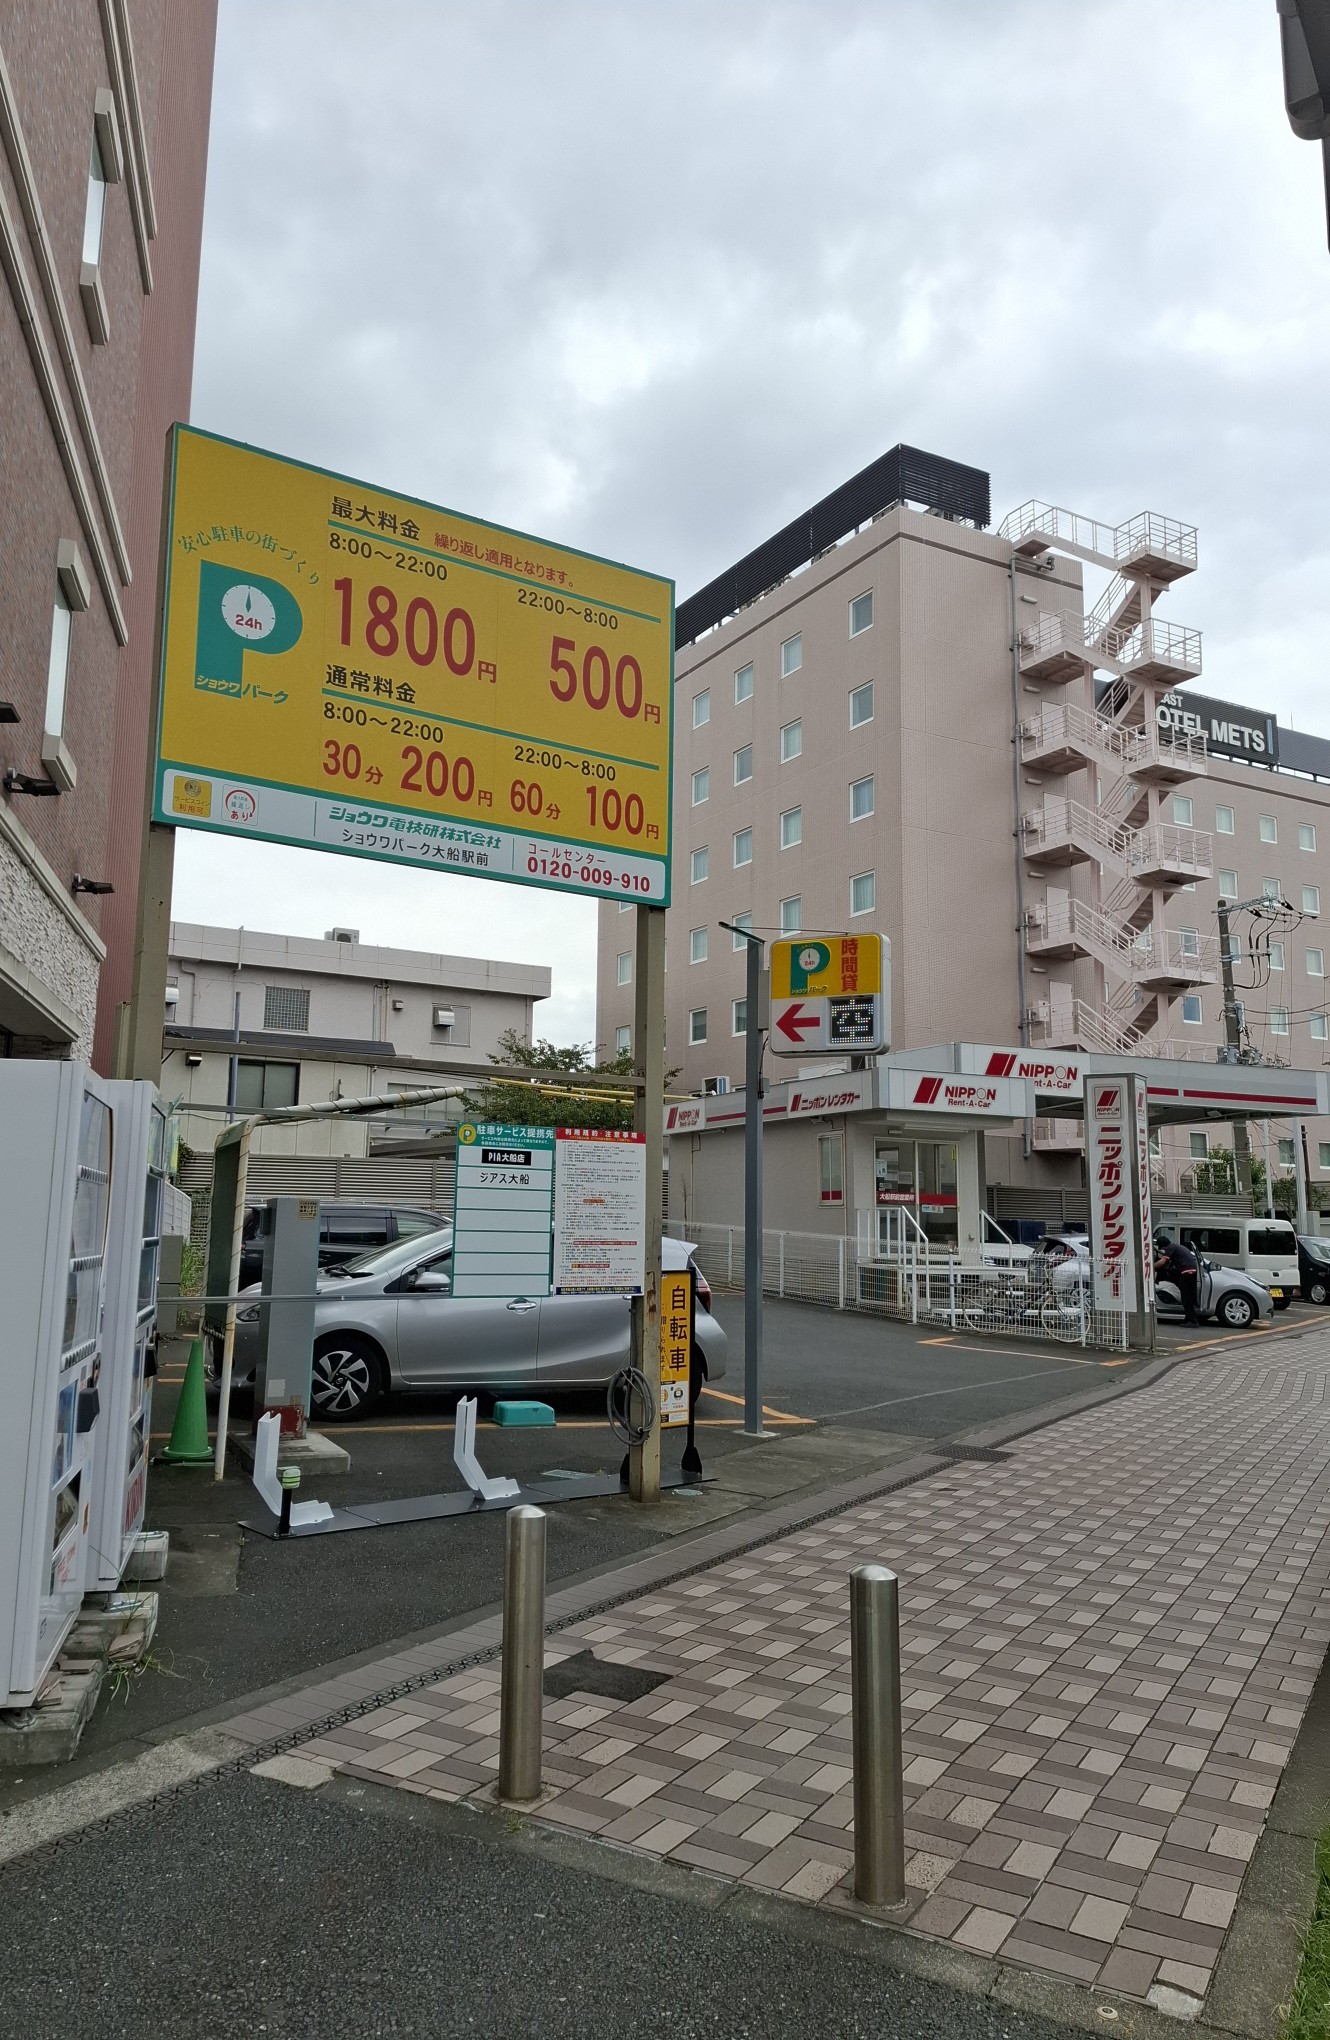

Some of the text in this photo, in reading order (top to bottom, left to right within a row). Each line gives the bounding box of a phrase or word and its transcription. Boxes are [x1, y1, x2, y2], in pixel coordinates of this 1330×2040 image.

[178, 525, 320, 585] 安心駐車の街づくり
[331, 496, 574, 588] 最大料金 繰り返し適用となります。
[235, 614, 262, 631] 24h
[334, 577, 497, 683] 1800円
[196, 675, 289, 704] ショウワパーク
[325, 664, 416, 704] 通常料金
[550, 635, 661, 724] 500円
[1160, 693, 1183, 708] AST
[1156, 705, 1265, 752] OTEL METS
[322, 739, 493, 807] 30分 200円
[174, 796, 209, 806] サービスコイン
[179, 804, 204, 814] 利用可
[231, 810, 249, 821] あり
[510, 779, 660, 840] 60分 100円
[328, 806, 502, 849] ショウワ電技研株式会社
[342, 828, 489, 866] ショウワパーク大船駅前
[528, 842, 606, 864] コールセンター
[527, 856, 651, 893] 0120-009-910
[841, 938, 859, 993] 時間貸
[831, 999, 874, 1043] 空
[1019, 1063, 1077, 1081] NIPPON
[1034, 1079, 1071, 1090] nt-A-Car
[944, 1085, 997, 1101] NIPPON
[947, 1097, 991, 1108] Rent-A-Car
[678, 1108, 700, 1121] NIPPON
[477, 1125, 554, 1139] 駐車サービス提携先
[488, 1152, 525, 1163] PIA大船店
[480, 1172, 530, 1185] ジアス大船
[669, 1285, 688, 1372] 自転車
